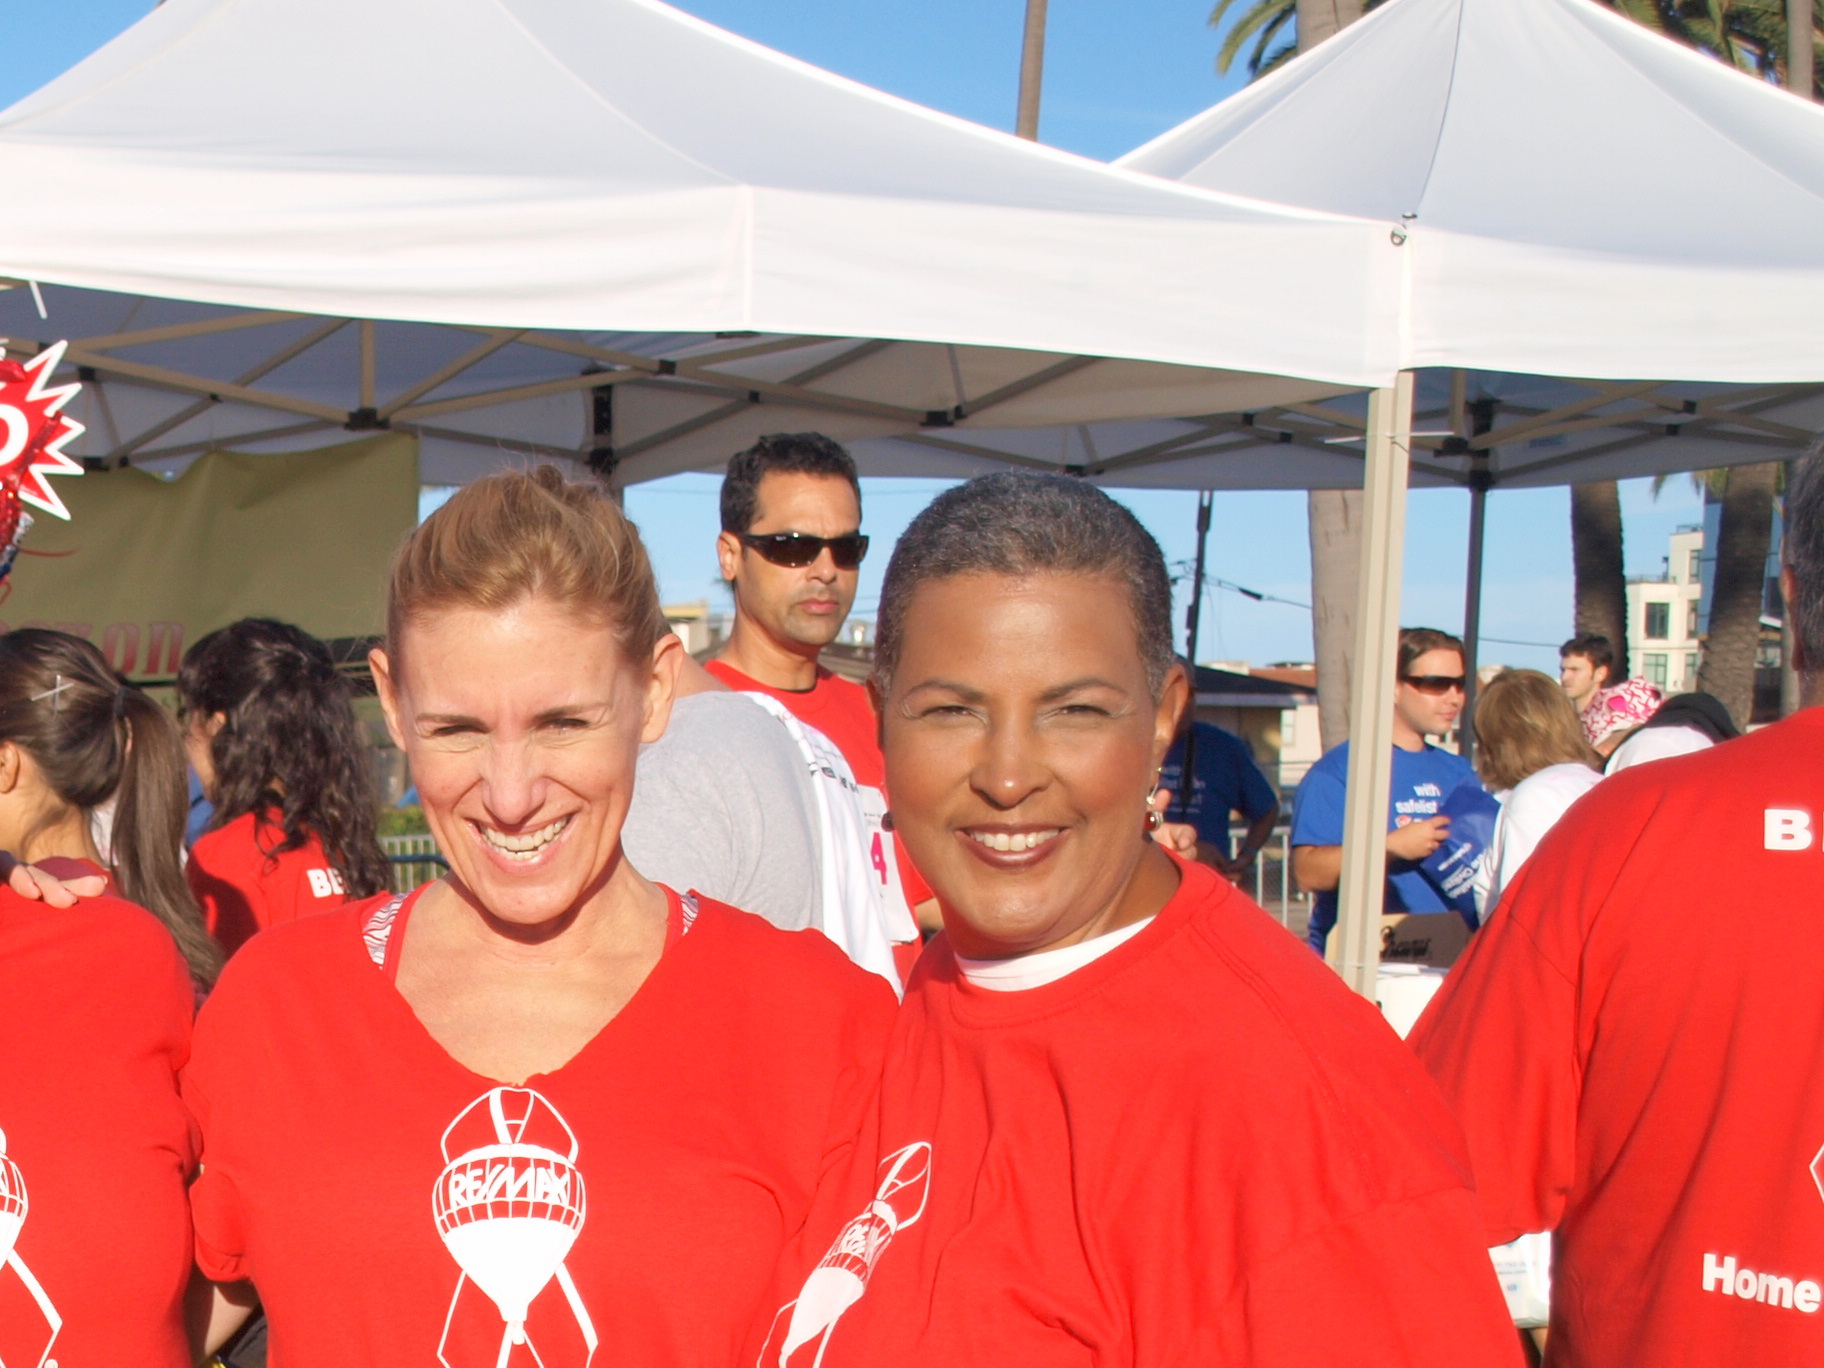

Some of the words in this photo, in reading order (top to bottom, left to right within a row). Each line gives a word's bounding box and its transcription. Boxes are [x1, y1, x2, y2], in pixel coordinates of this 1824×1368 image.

[1764, 809, 1824, 850] B
[447, 1165, 571, 1206] RE/MAX
[1702, 1253, 1821, 1314] Home
